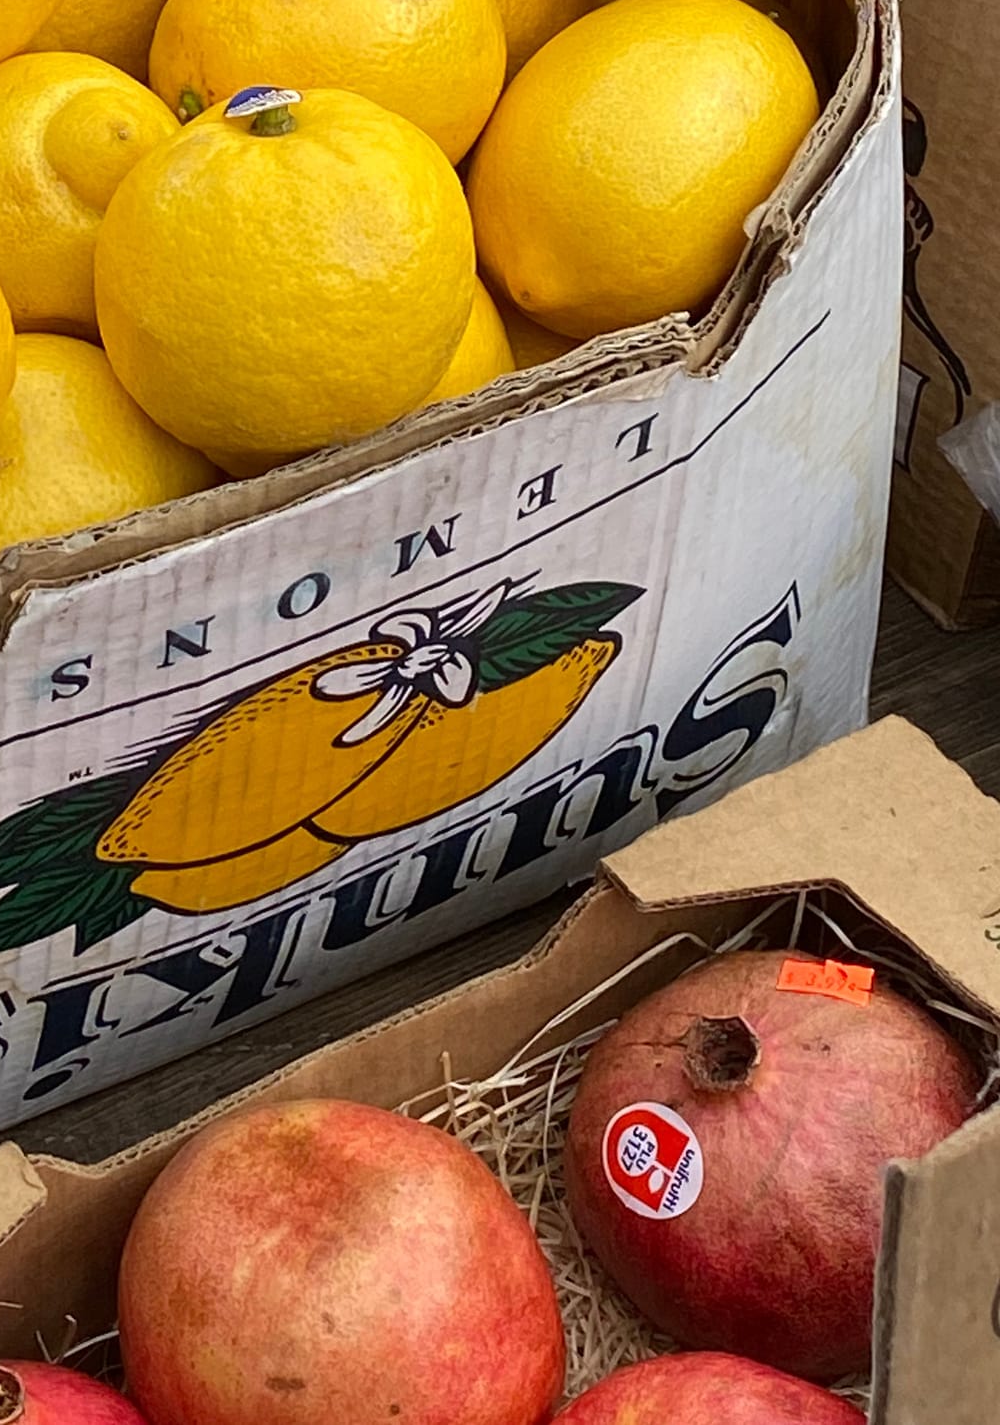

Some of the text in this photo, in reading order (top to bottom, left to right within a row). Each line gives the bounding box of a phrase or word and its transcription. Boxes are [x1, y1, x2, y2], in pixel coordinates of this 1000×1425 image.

[50, 412, 660, 703] LEMONS
[620, 1125, 649, 1172] 3127
[635, 1141, 656, 1171] PLU
[662, 1148, 696, 1213] unifrutti
